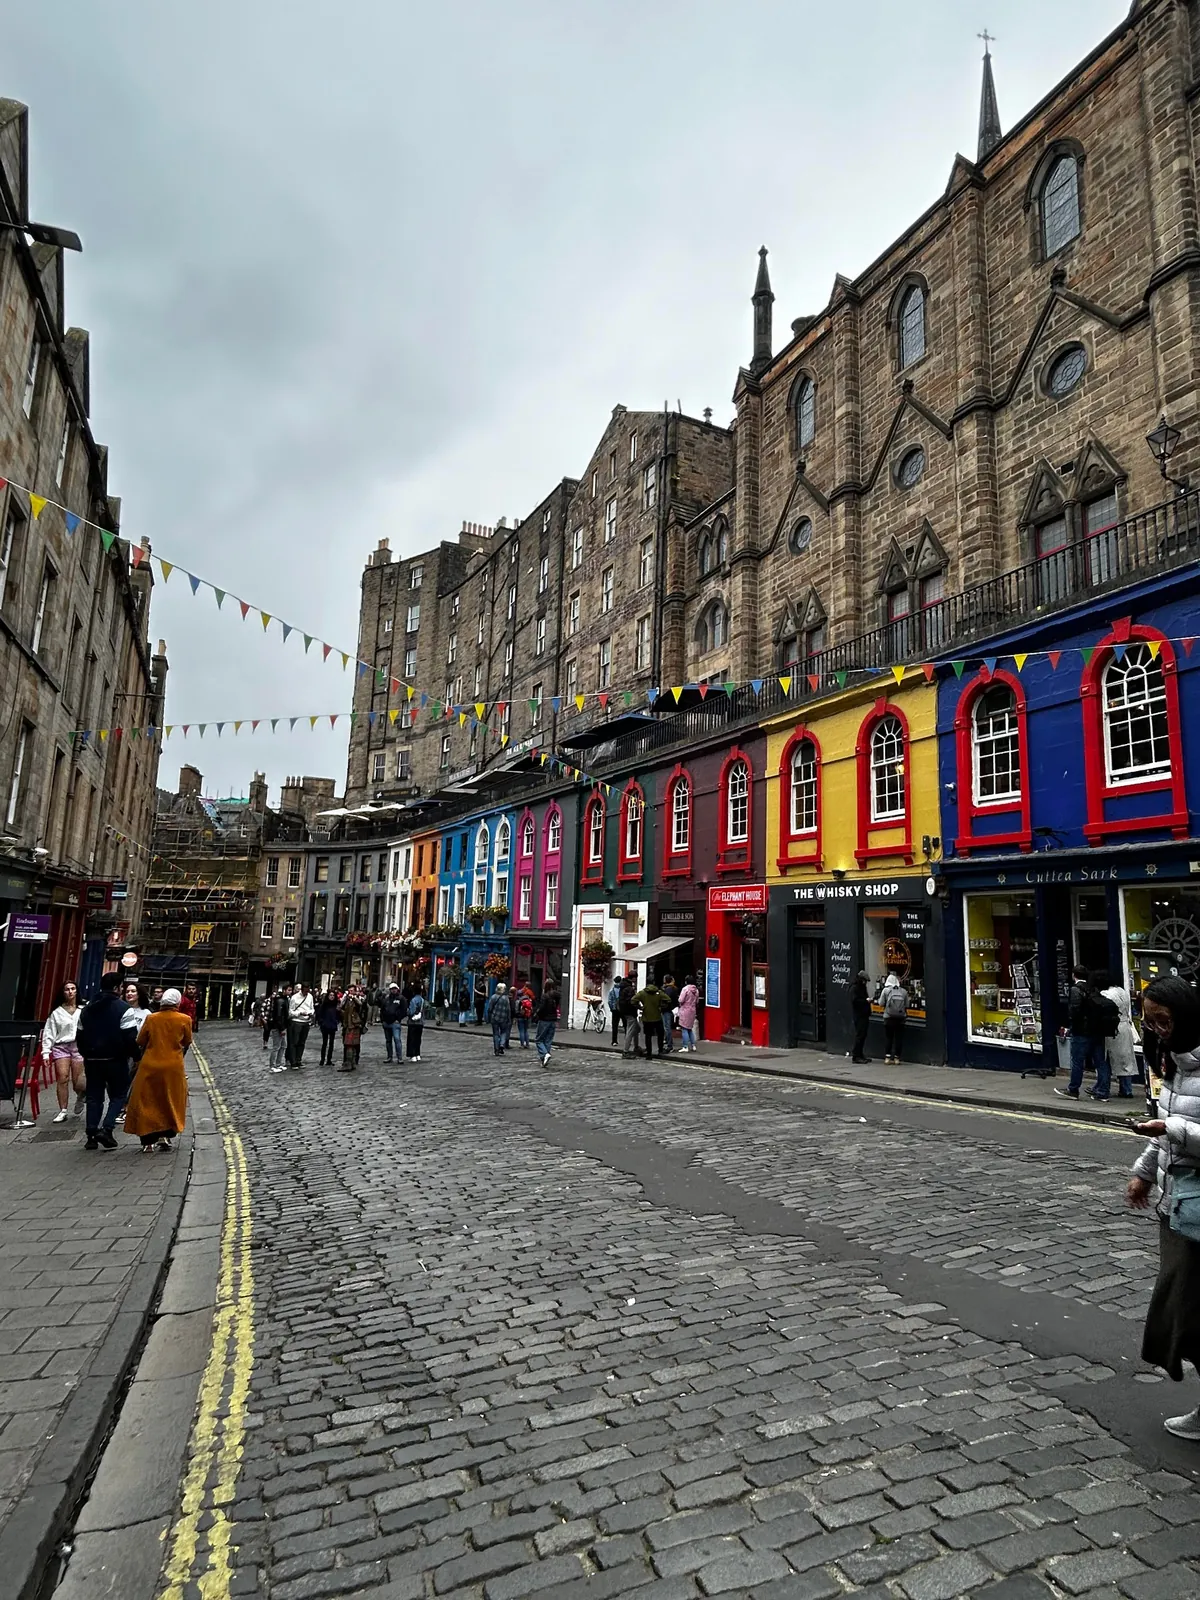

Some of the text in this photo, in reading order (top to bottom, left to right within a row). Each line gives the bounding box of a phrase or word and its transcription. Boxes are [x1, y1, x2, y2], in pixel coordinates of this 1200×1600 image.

[1025, 865, 1118, 884] Cuttea Sark
[722, 891, 745, 902] ELEPHANT
[745, 889, 762, 901] HOUSE
[793, 883, 899, 899] THE WHISKY SHOP
[901, 922, 925, 930] WHISKY
